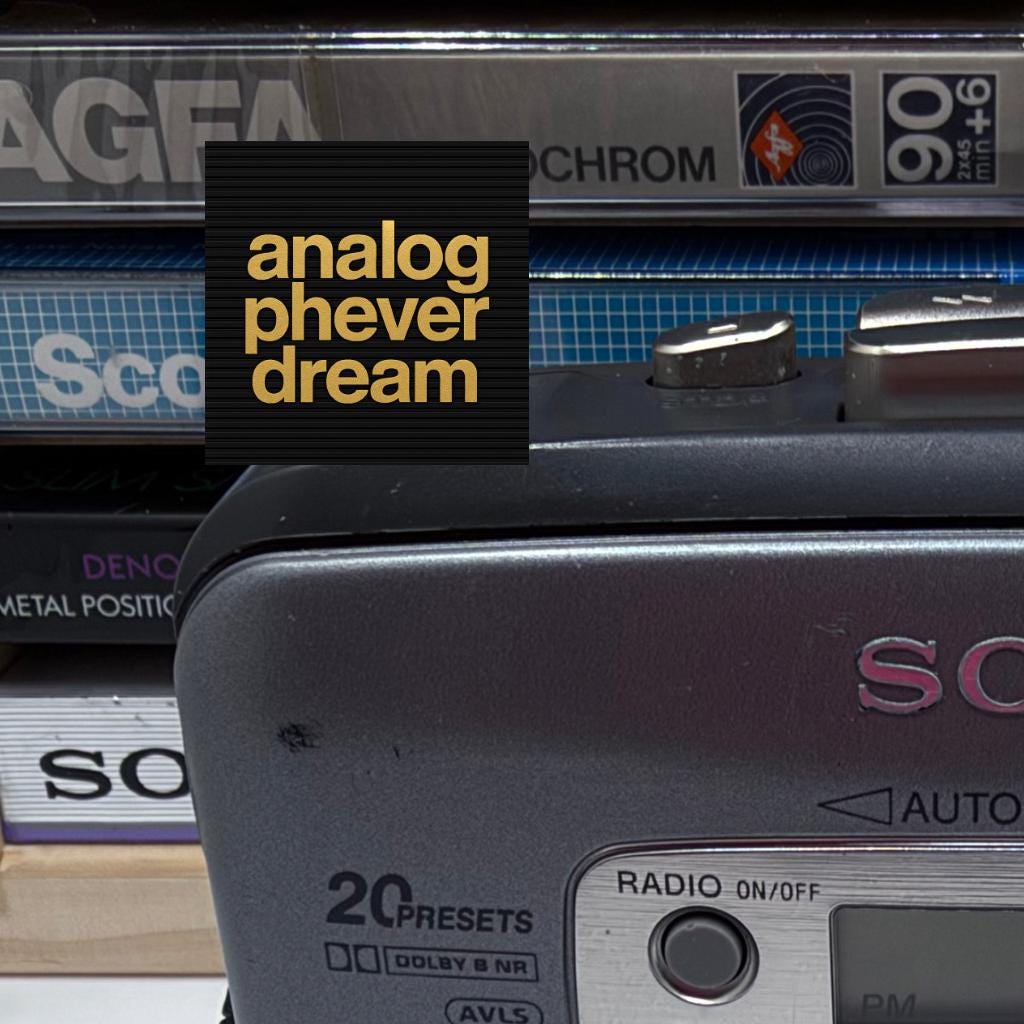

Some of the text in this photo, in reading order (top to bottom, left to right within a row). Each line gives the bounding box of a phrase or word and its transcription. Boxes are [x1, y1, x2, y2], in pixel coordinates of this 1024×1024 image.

[887, 76, 953, 182] 90
[529, 145, 716, 182] CHROM
[972, 139, 991, 180] min
[902, 792, 1021, 825] AUTO
[617, 870, 821, 901] RADIO ON/OFF
[326, 871, 534, 934] 20 PRESETS
[395, 954, 528, 974] DOLBY B NR
[459, 1005, 529, 1024] AVLS
[861, 993, 917, 1018] PM
